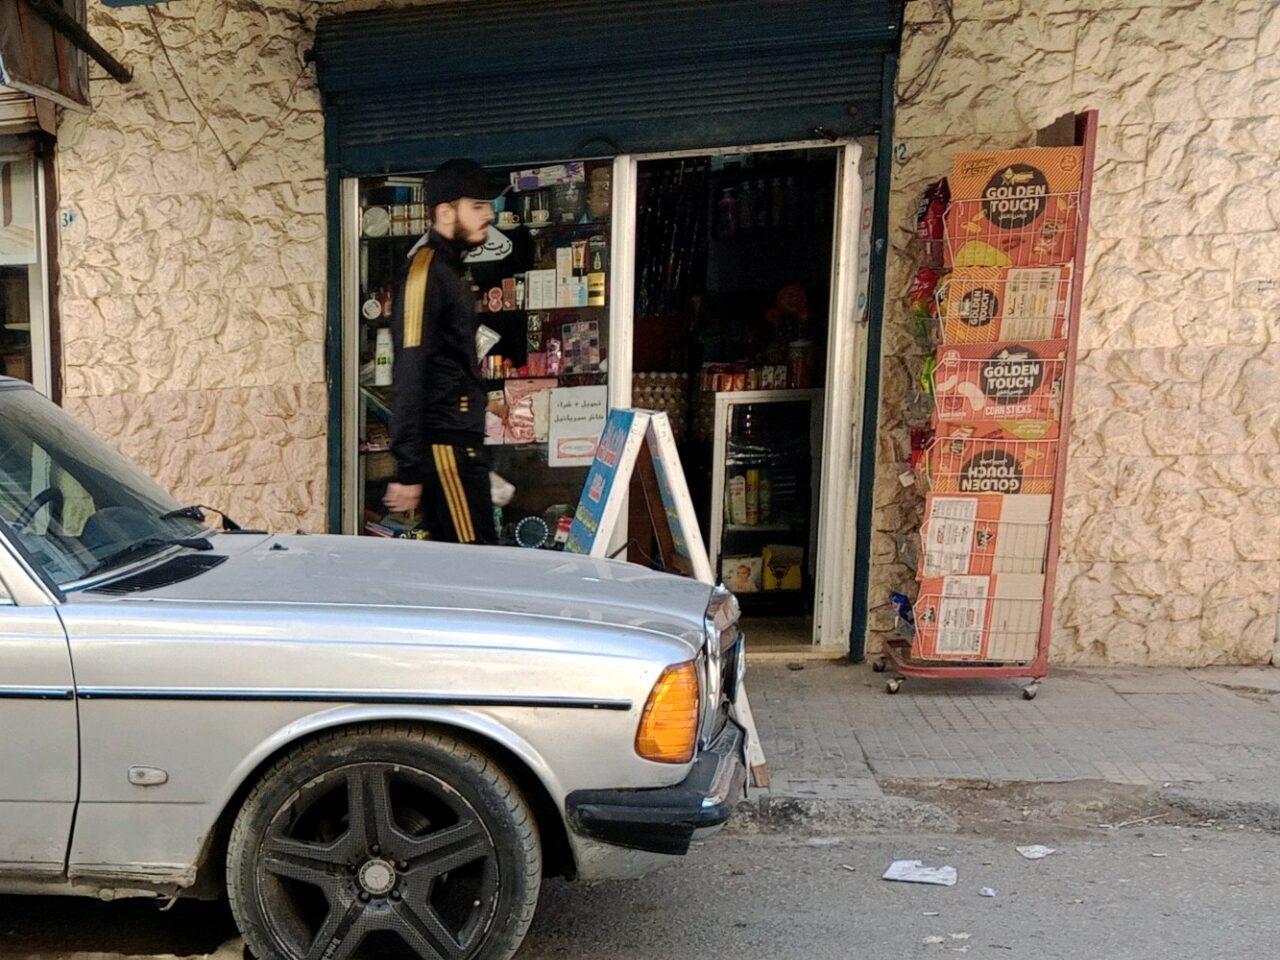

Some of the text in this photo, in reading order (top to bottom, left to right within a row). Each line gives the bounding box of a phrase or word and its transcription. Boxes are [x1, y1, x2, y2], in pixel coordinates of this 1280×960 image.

[986, 184, 1046, 200] GOLDEN
[990, 198, 1039, 212] TOUCH
[984, 364, 1039, 377] GOLDEN
[988, 376, 1034, 390] TOUCH
[967, 466, 1016, 478] TOUCH
[961, 479, 1020, 491] GOLDEN
